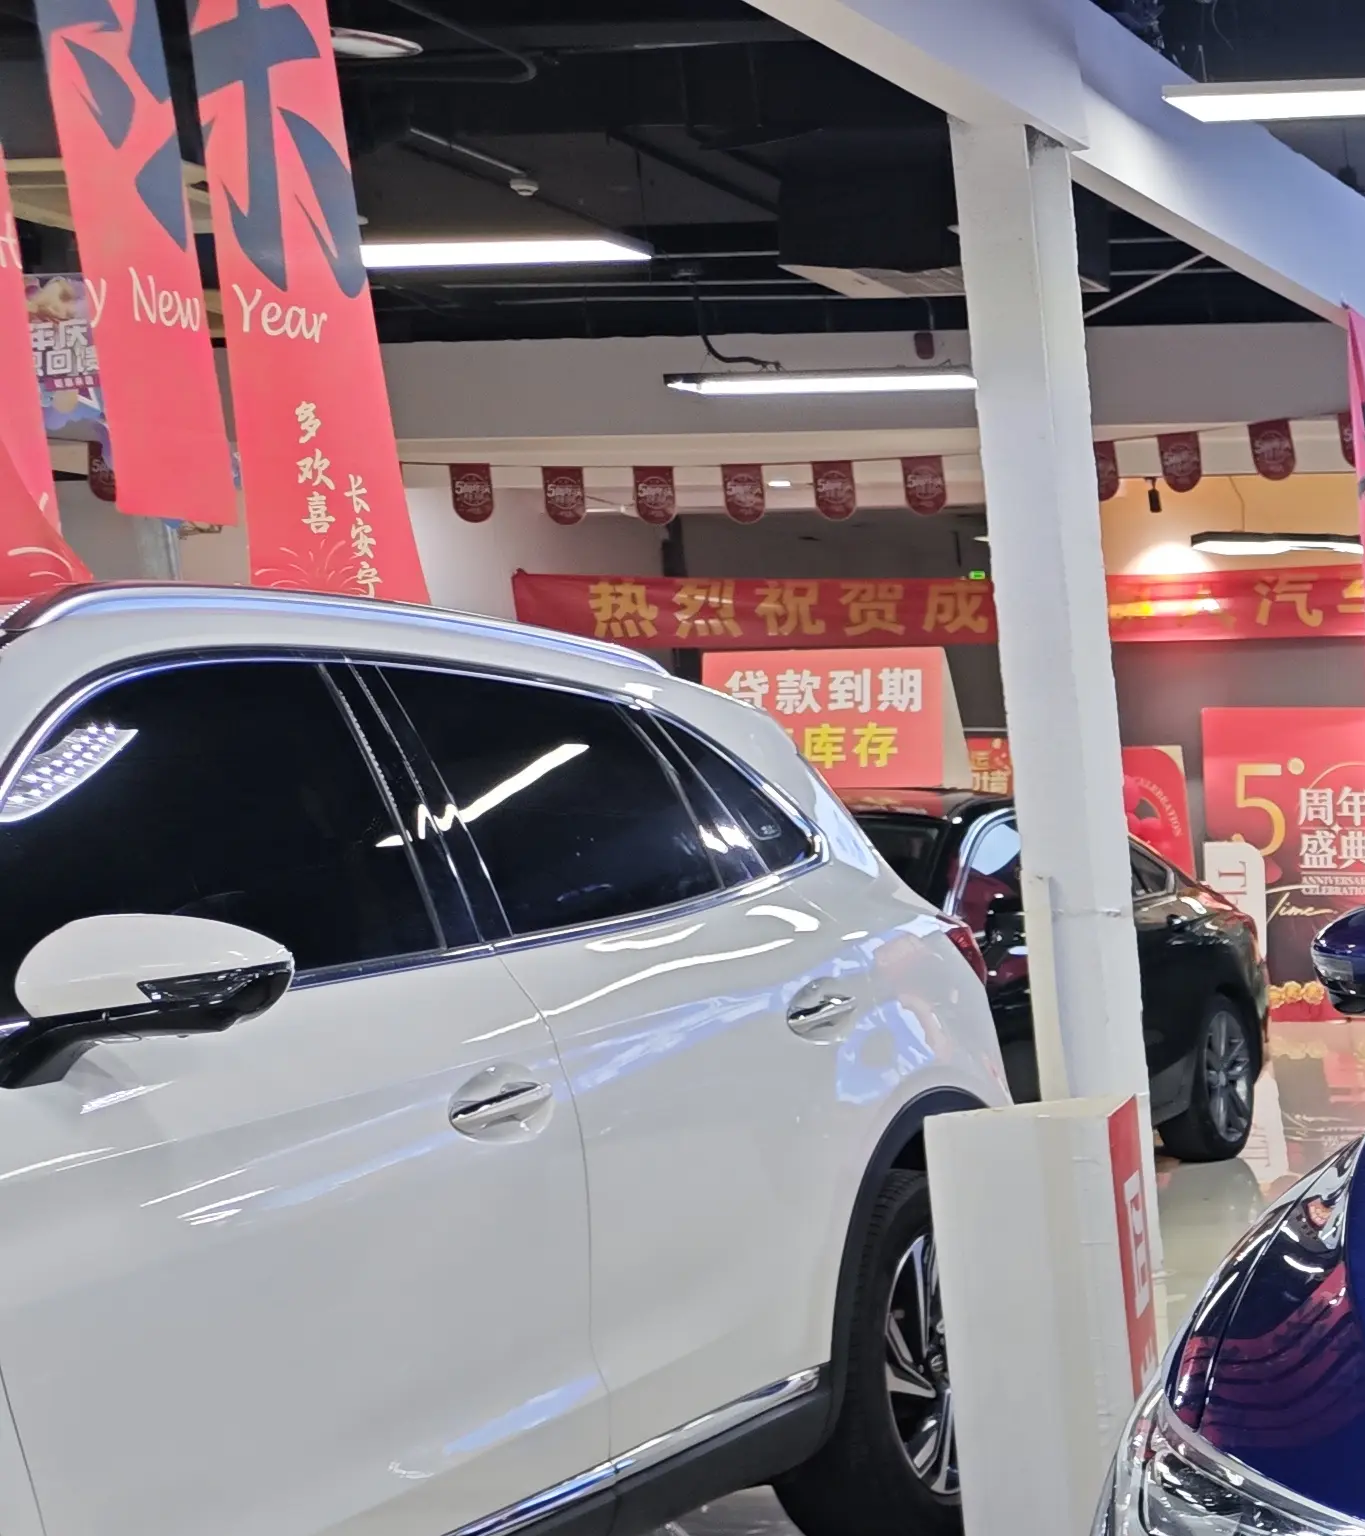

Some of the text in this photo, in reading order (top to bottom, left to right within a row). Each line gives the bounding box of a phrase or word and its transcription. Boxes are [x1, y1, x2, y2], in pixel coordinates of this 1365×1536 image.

[128, 266, 200, 332] New
[232, 283, 328, 345] Year
[295, 401, 335, 535] 多欢喜
[589, 579, 990, 638] 热烈祝贺成
[725, 666, 922, 714] 贷款到期
[787, 722, 898, 769] 库存
